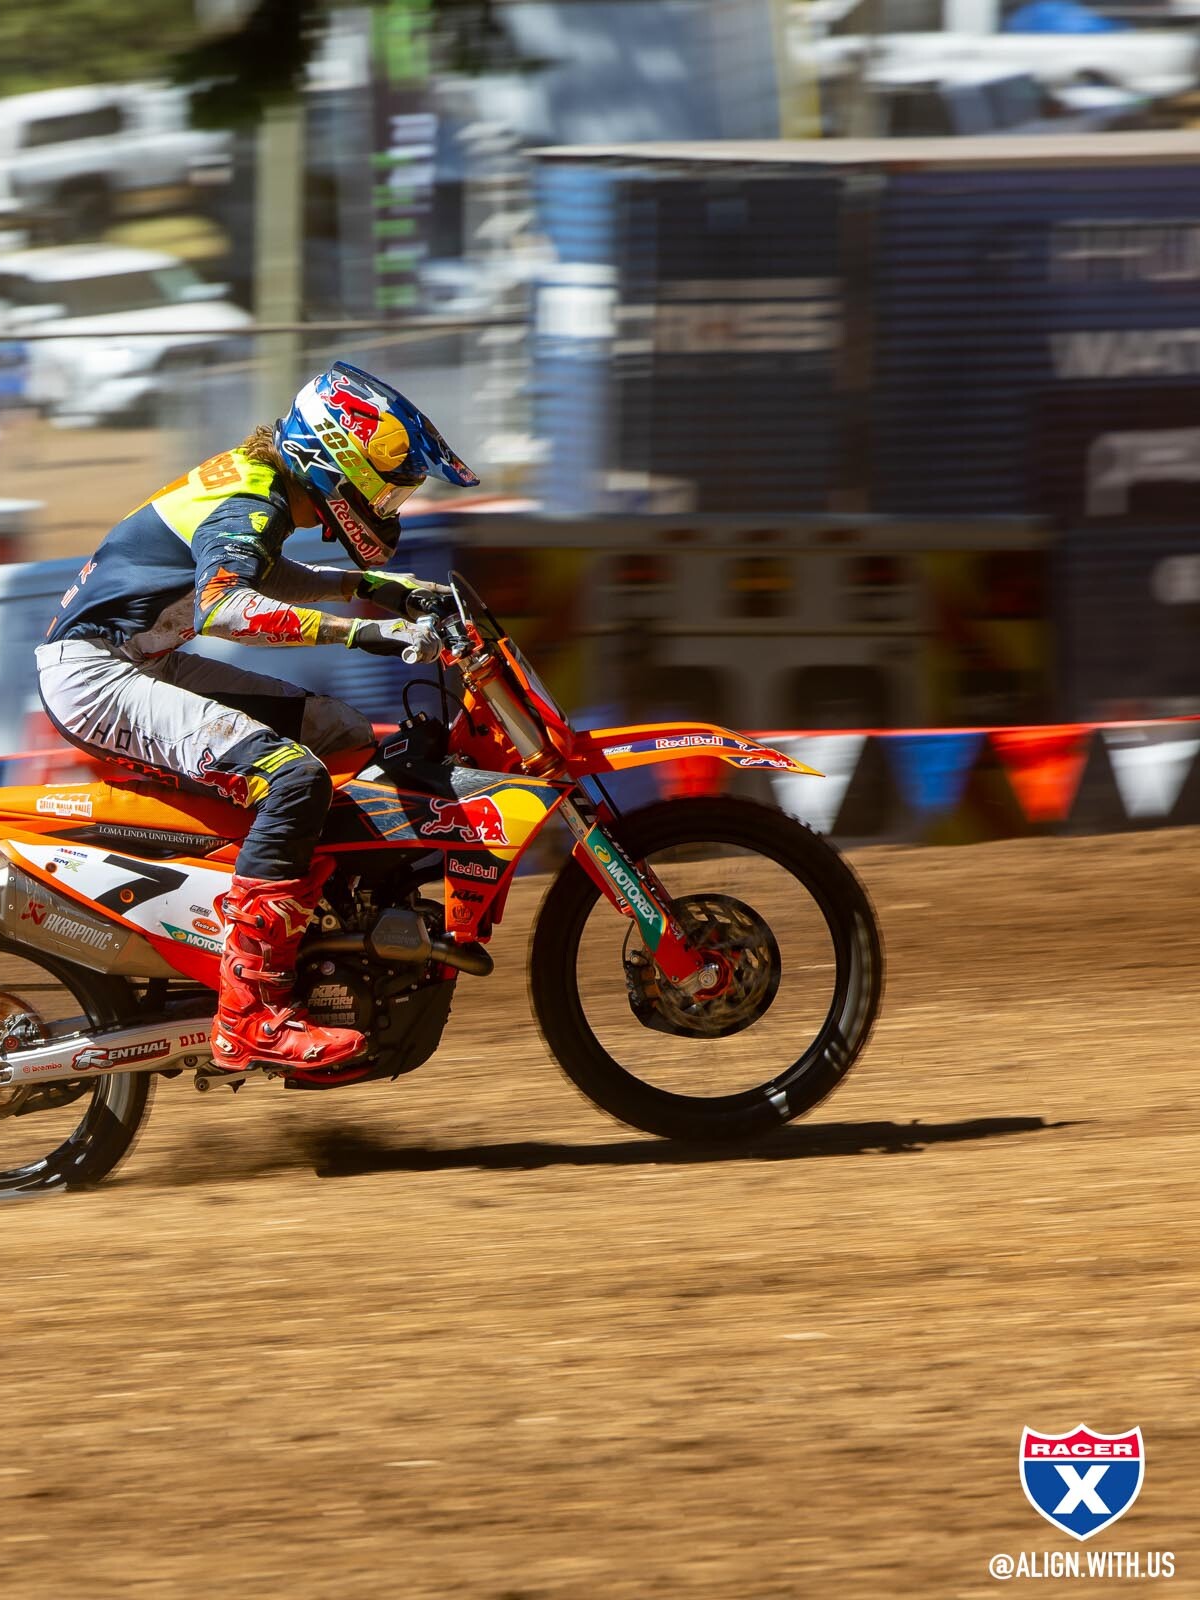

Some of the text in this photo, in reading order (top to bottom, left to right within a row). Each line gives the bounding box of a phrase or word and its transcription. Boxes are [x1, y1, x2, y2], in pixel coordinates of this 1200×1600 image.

[99, 825, 122, 836] LOMA
[123, 828, 147, 840] LINDA
[148, 831, 194, 845] UNIVERSITY
[448, 858, 498, 880] Red Bull
[95, 853, 189, 915] 7
[606, 859, 659, 925] MOTOREX
[186, 933, 224, 954] MOTOR
[73, 1039, 170, 1069] RENTHAL
[31, 1062, 63, 1072] brembo
